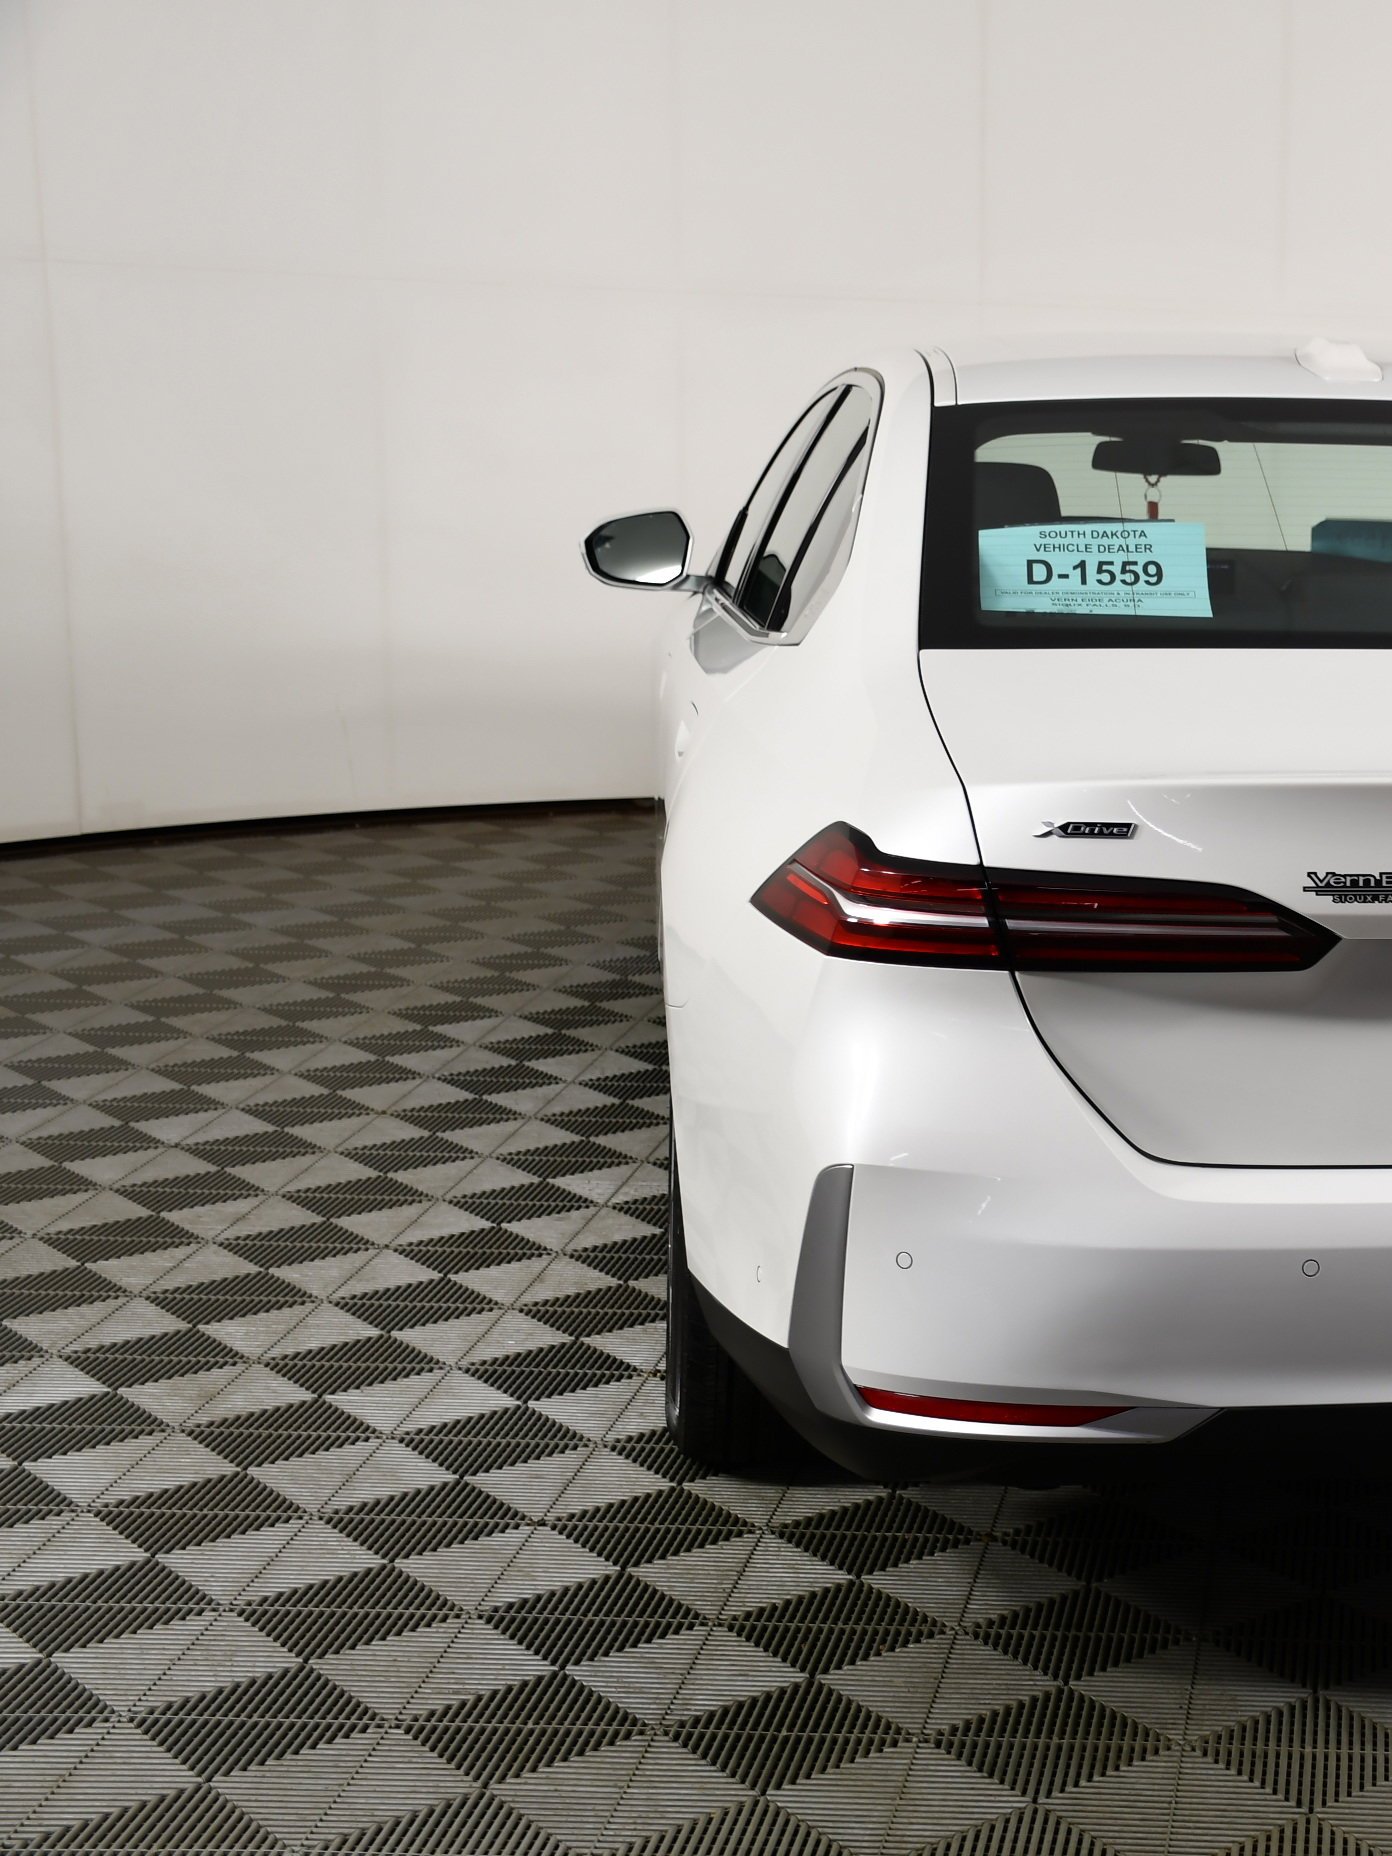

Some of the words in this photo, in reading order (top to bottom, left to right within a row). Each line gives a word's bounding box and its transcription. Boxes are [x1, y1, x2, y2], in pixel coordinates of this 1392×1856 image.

[1039, 530, 1086, 539] SOUTH
[1090, 530, 1148, 539] DAKOTA
[1033, 543, 1093, 553] VEHICLE
[1097, 544, 1153, 553] DEALER
[1026, 559, 1164, 586] D-1559
[1308, 873, 1376, 887] Vern
[1333, 895, 1373, 903] SIOUX
